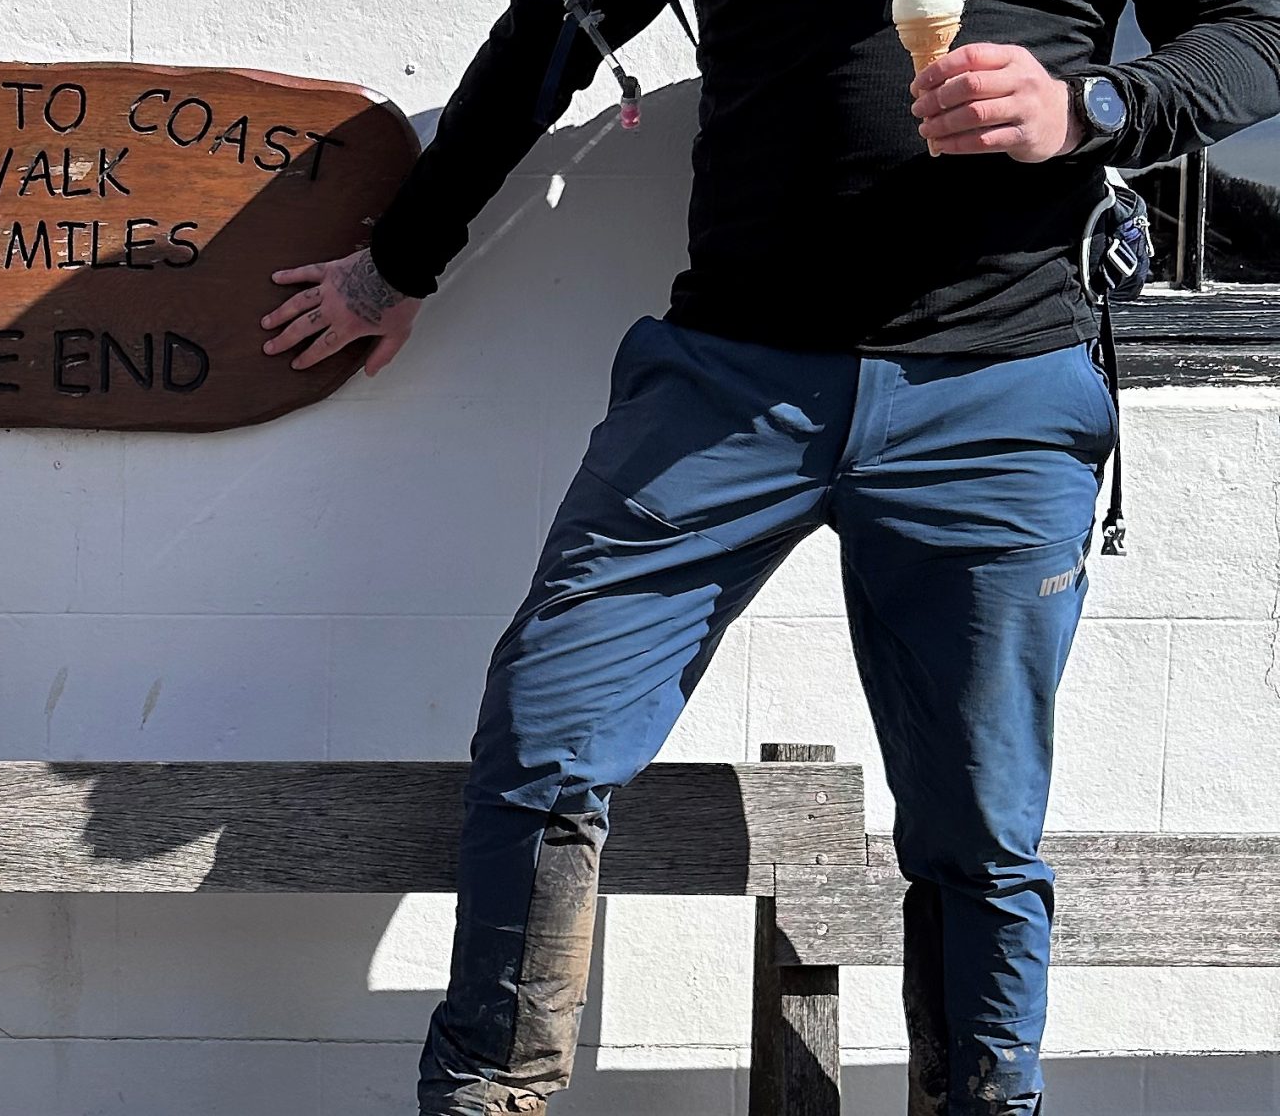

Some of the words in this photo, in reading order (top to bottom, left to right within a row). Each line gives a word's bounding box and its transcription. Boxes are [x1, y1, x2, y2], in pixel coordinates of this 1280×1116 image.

[1, 82, 87, 133] TO
[127, 88, 346, 182] COAST
[52, 329, 211, 399] END
